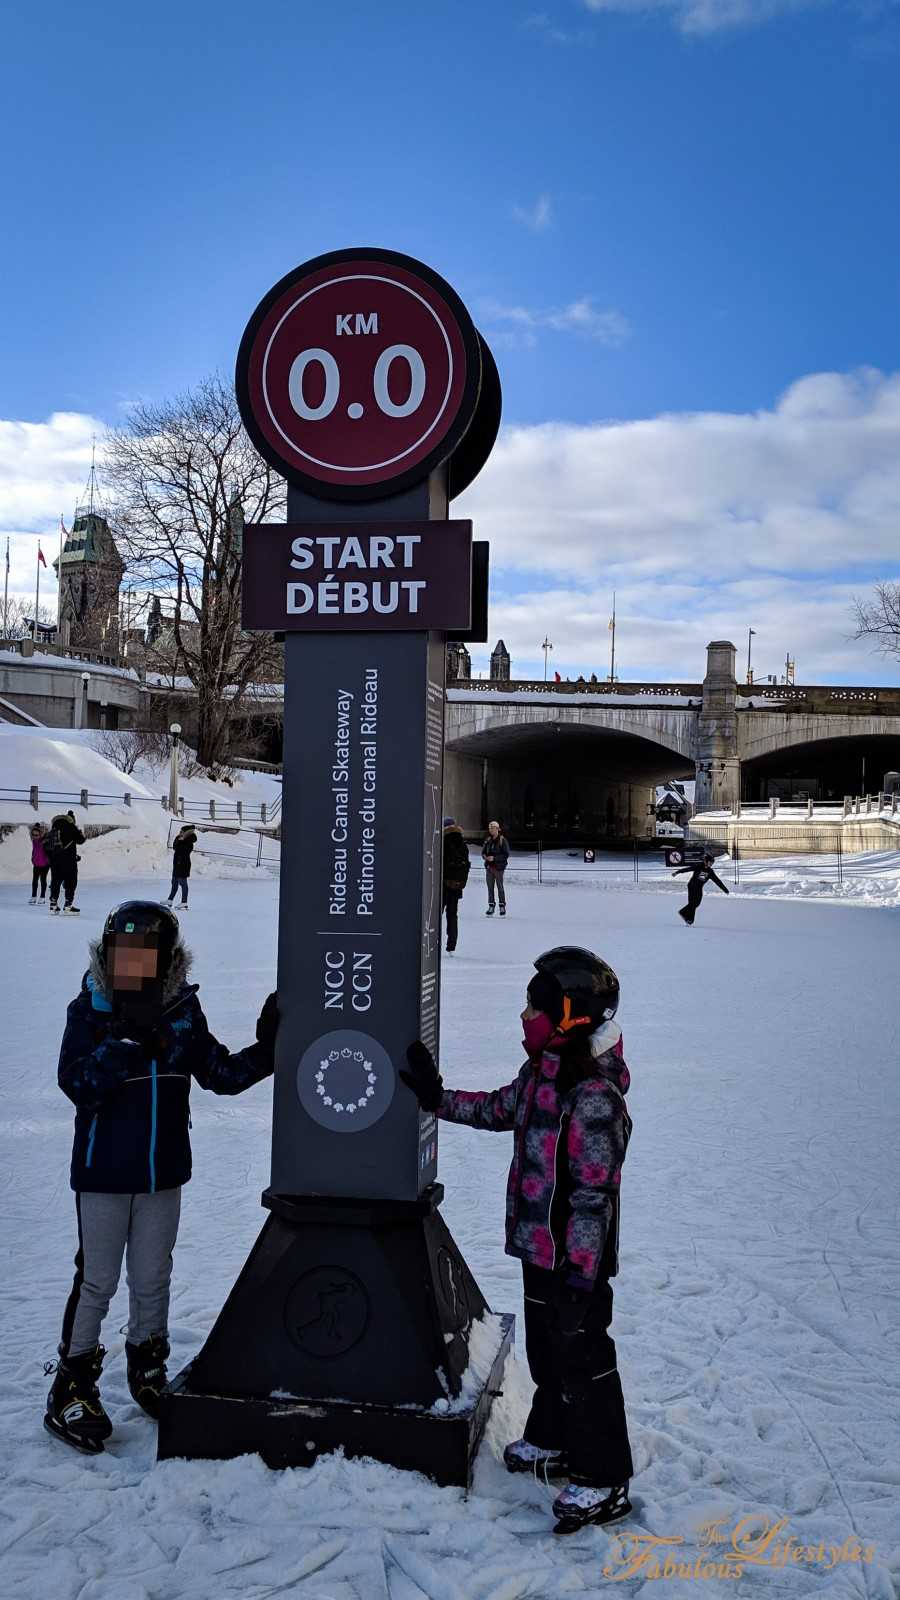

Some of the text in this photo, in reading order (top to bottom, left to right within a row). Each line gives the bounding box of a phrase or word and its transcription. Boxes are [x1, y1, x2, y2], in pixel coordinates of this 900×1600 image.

[336, 313, 378, 336] KM
[288, 344, 426, 421] 0.0
[290, 535, 421, 570] START
[286, 574, 426, 614] DÉBUT
[328, 688, 355, 915] Rideau Canal Skateway
[356, 668, 378, 916] Patinoire du canal Rideau
[324, 951, 345, 1011] NCC
[351, 951, 373, 1012] CCN
